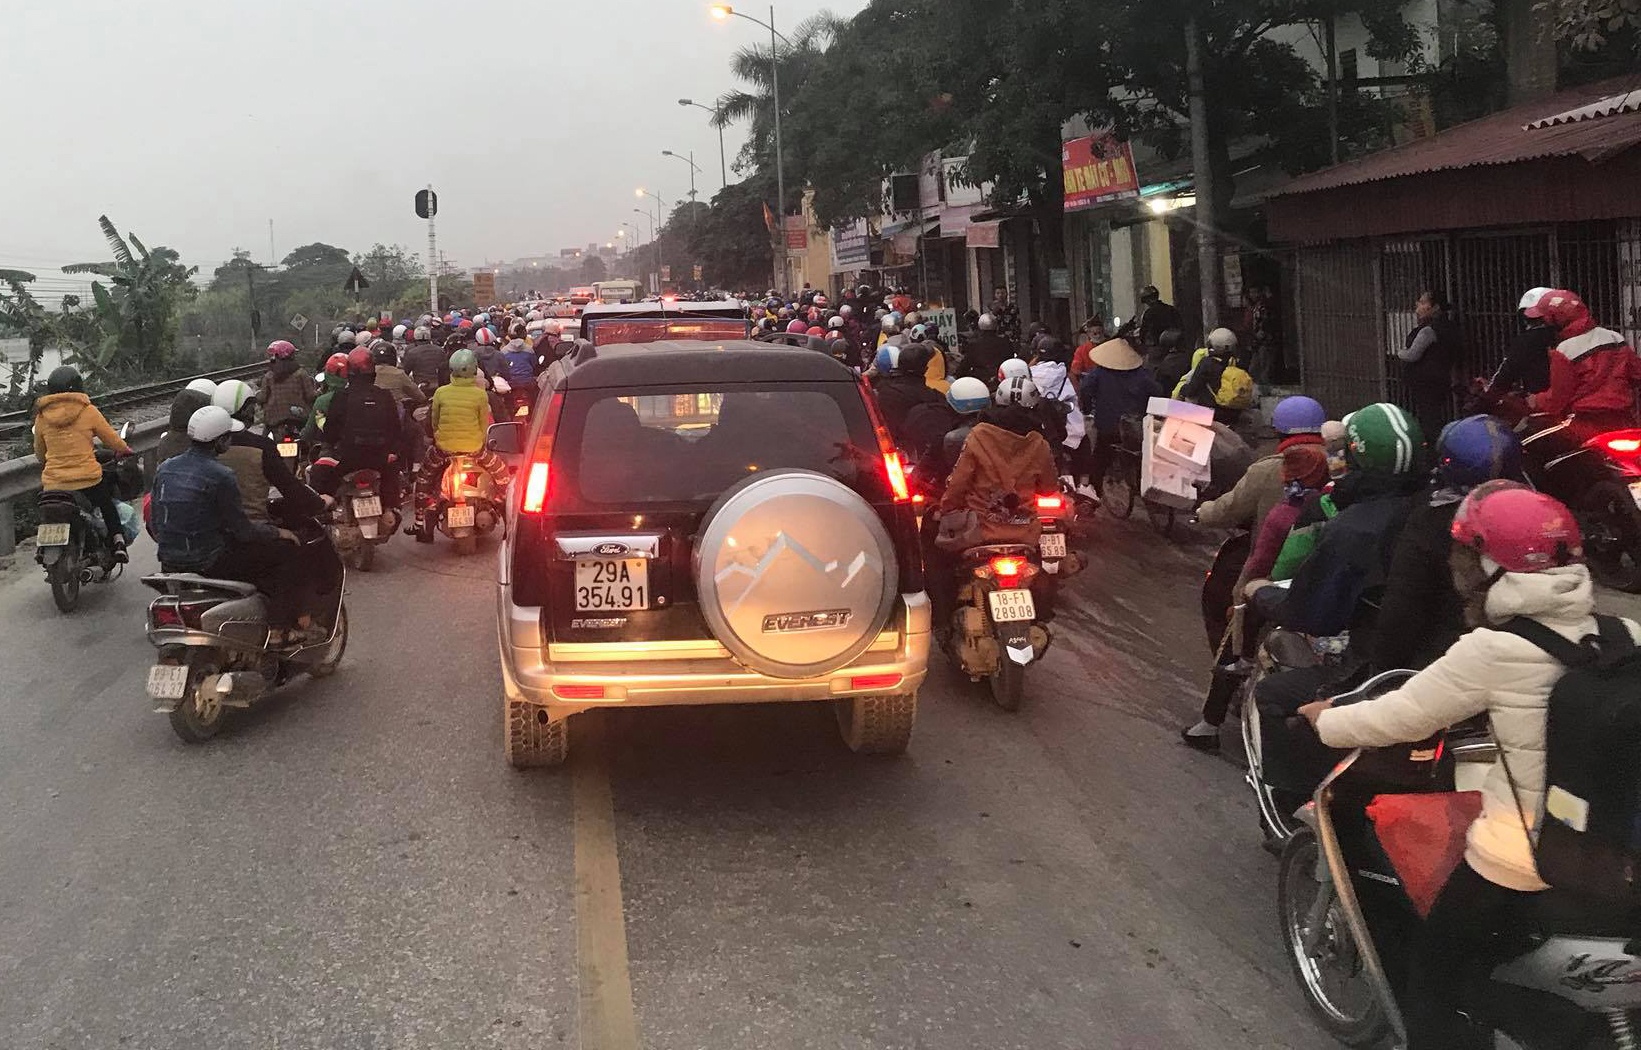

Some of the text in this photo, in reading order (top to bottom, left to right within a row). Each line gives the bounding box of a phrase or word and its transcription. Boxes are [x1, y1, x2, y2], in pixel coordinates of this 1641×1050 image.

[600, 544, 621, 554] Ford
[592, 560, 631, 584] 29A
[577, 585, 645, 609] 354.91
[996, 591, 1026, 606] 18-F1
[994, 604, 1033, 620] 289.08
